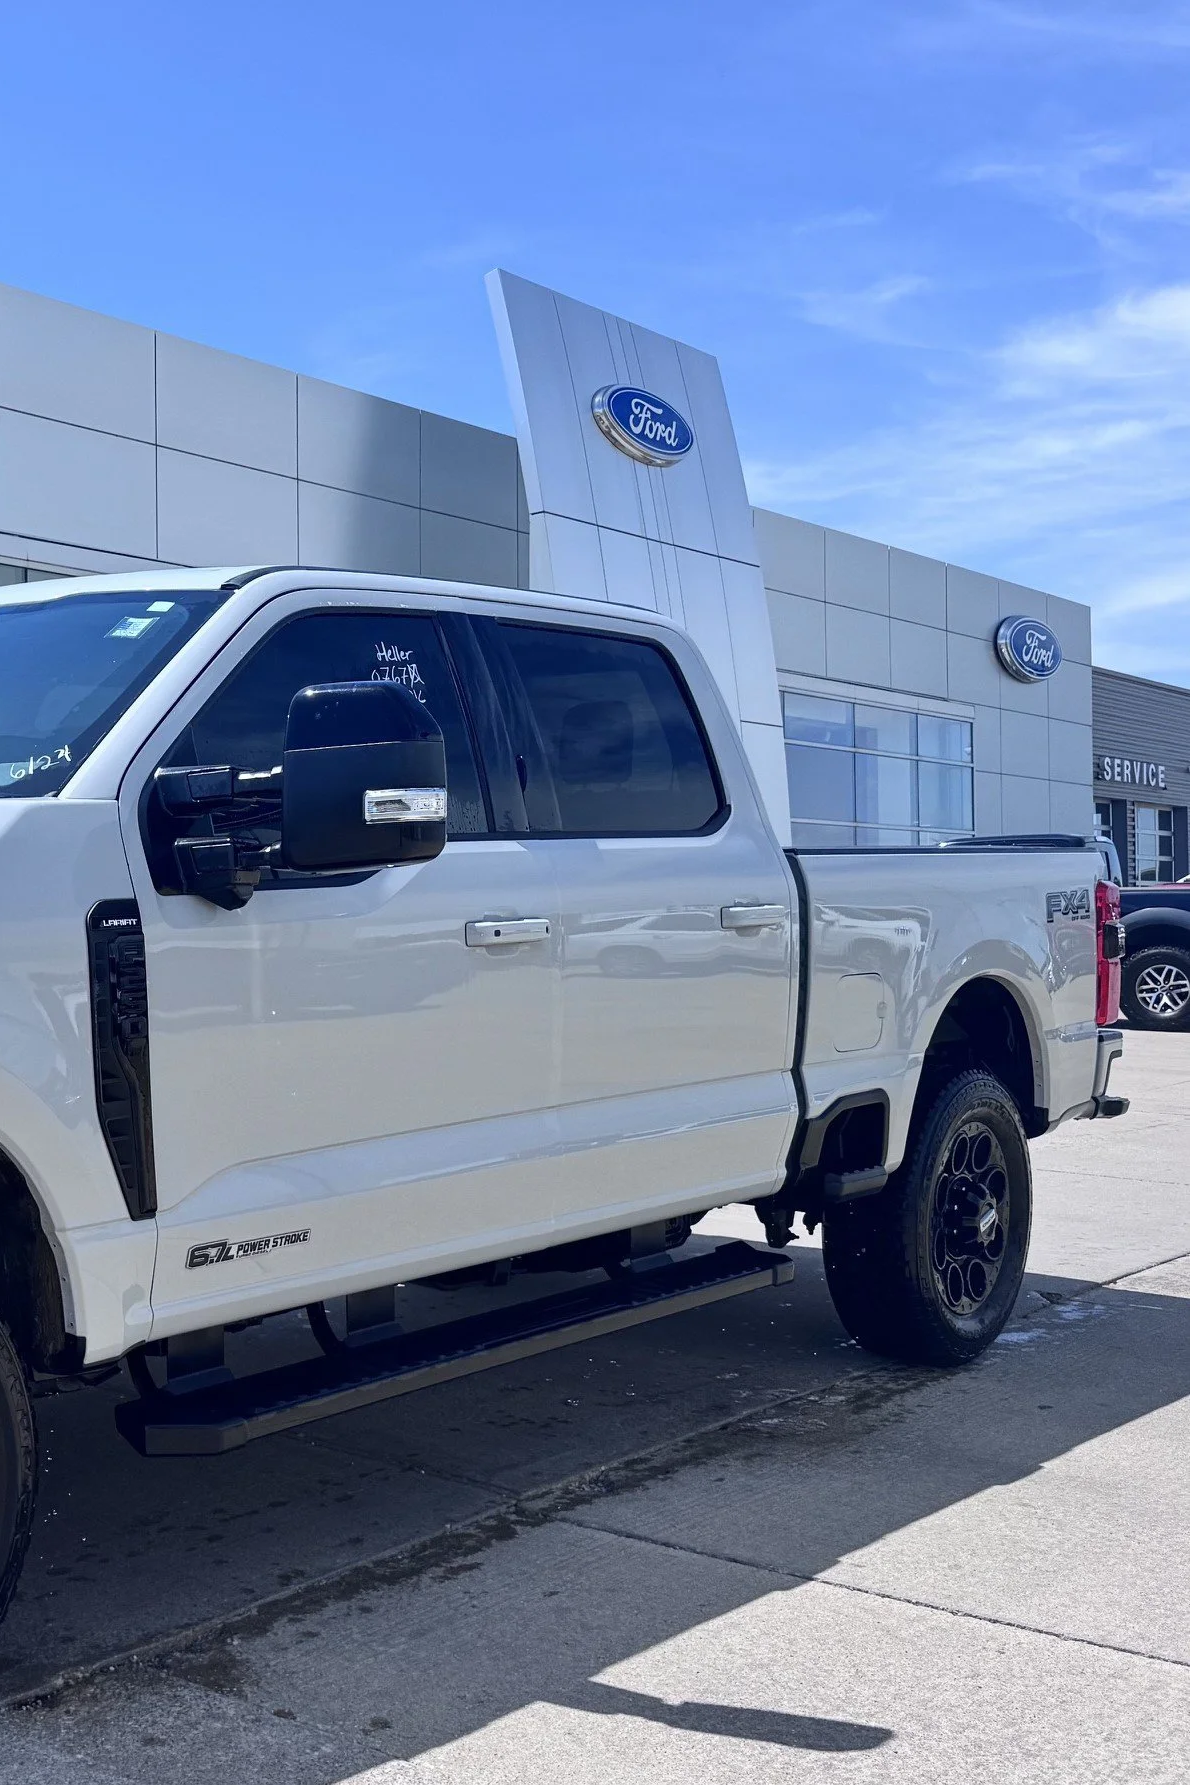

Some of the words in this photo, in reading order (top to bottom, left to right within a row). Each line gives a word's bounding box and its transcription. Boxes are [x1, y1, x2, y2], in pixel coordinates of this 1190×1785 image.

[629, 398, 679, 447] Ford
[375, 641, 414, 661] Heller
[1022, 629, 1054, 668] Ford
[1103, 756, 1166, 788] SERVICE
[1046, 889, 1090, 923] FX4
[236, 1239, 271, 1255] POWER
[271, 1230, 310, 1248] STROKE
